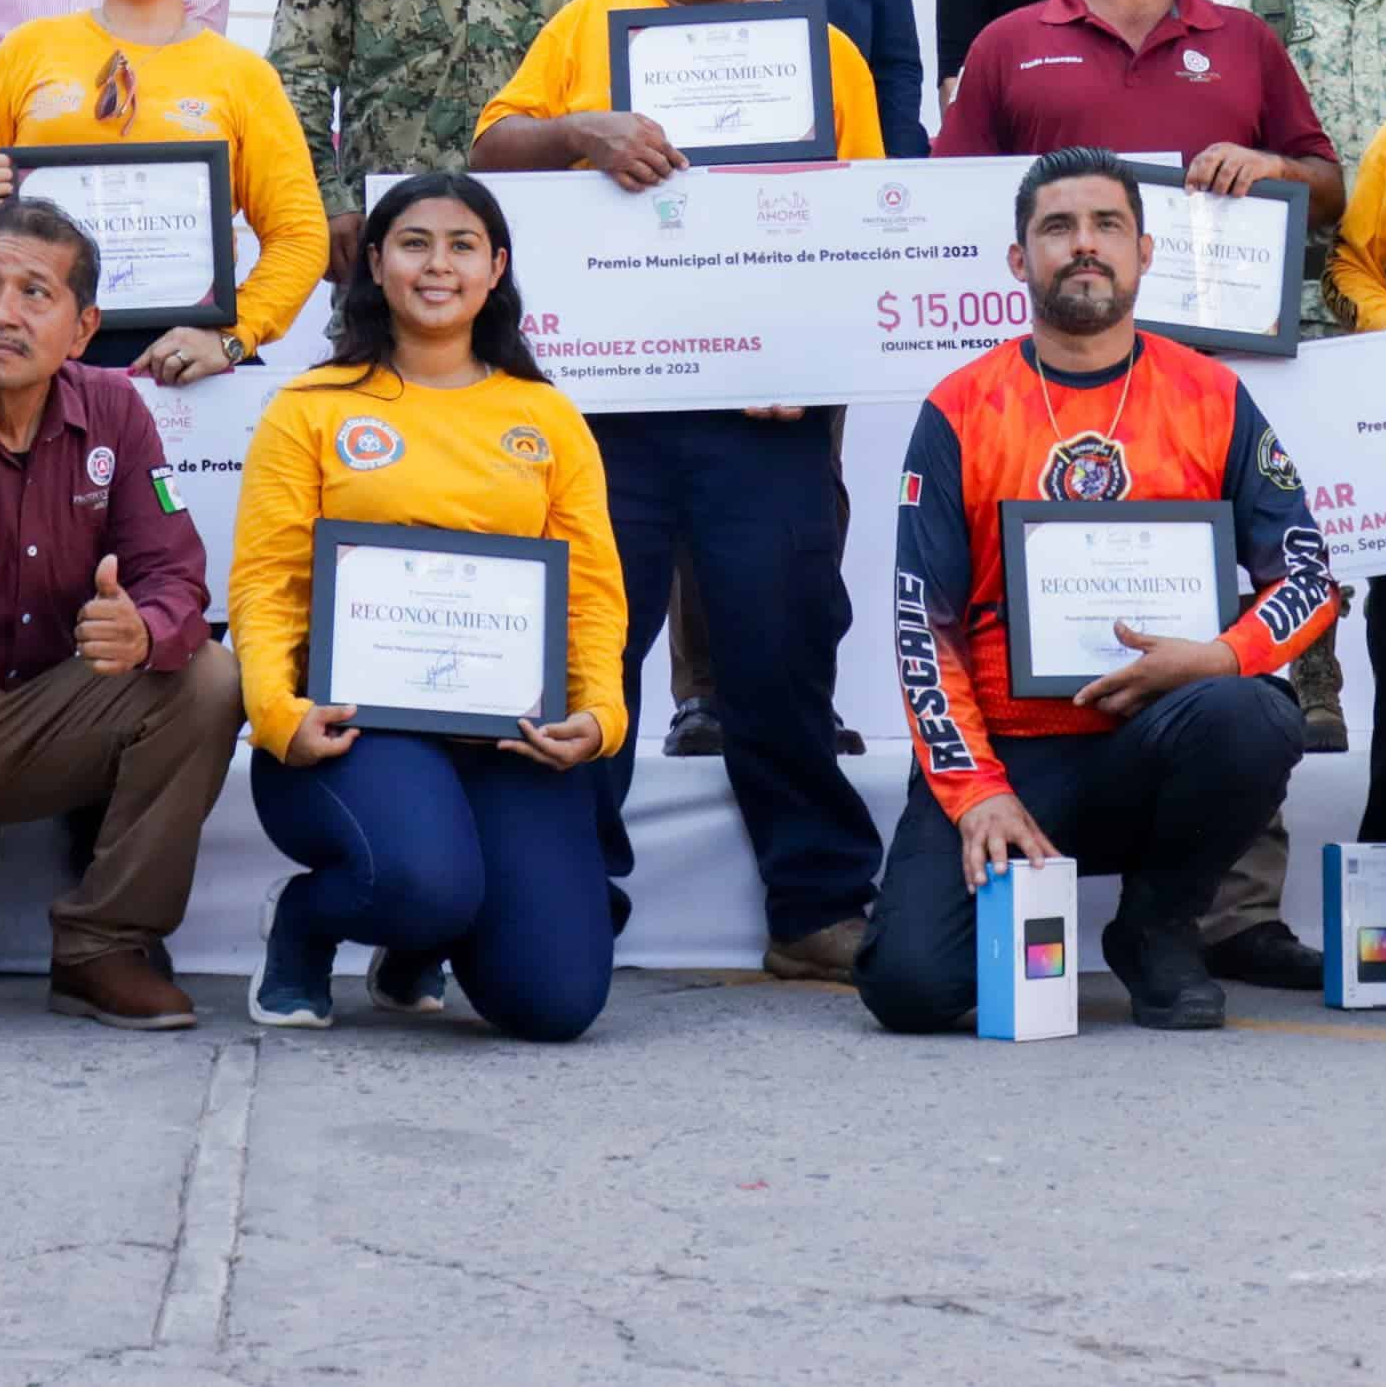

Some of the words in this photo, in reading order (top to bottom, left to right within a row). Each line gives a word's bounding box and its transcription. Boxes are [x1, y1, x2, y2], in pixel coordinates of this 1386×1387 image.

[645, 63, 797, 86] RECONOCIMIENTO
[587, 255, 642, 270] Premio
[645, 251, 720, 270] Municipal
[725, 250, 740, 265] al
[743, 248, 793, 264] Mérito
[796, 248, 816, 263] de
[819, 245, 901, 262] Protección
[905, 245, 939, 260] Civil
[942, 245, 979, 259] 2023
[877, 291, 901, 333] $
[641, 335, 762, 355] CONTRERAS
[881, 340, 934, 353] (QUINCE
[937, 340, 958, 351] MIL
[961, 337, 1000, 350] PESOS
[562, 364, 642, 380] Septiembre
[645, 363, 662, 375] de
[667, 362, 700, 375] 2023
[178, 460, 197, 472] de
[1305, 483, 1356, 512] AR
[1317, 517, 1354, 536] AN
[1041, 577, 1202, 595] RECONOCIMIENTO
[350, 602, 528, 633] RECONOCIMIENTO
[896, 566, 978, 774] RESCATE
